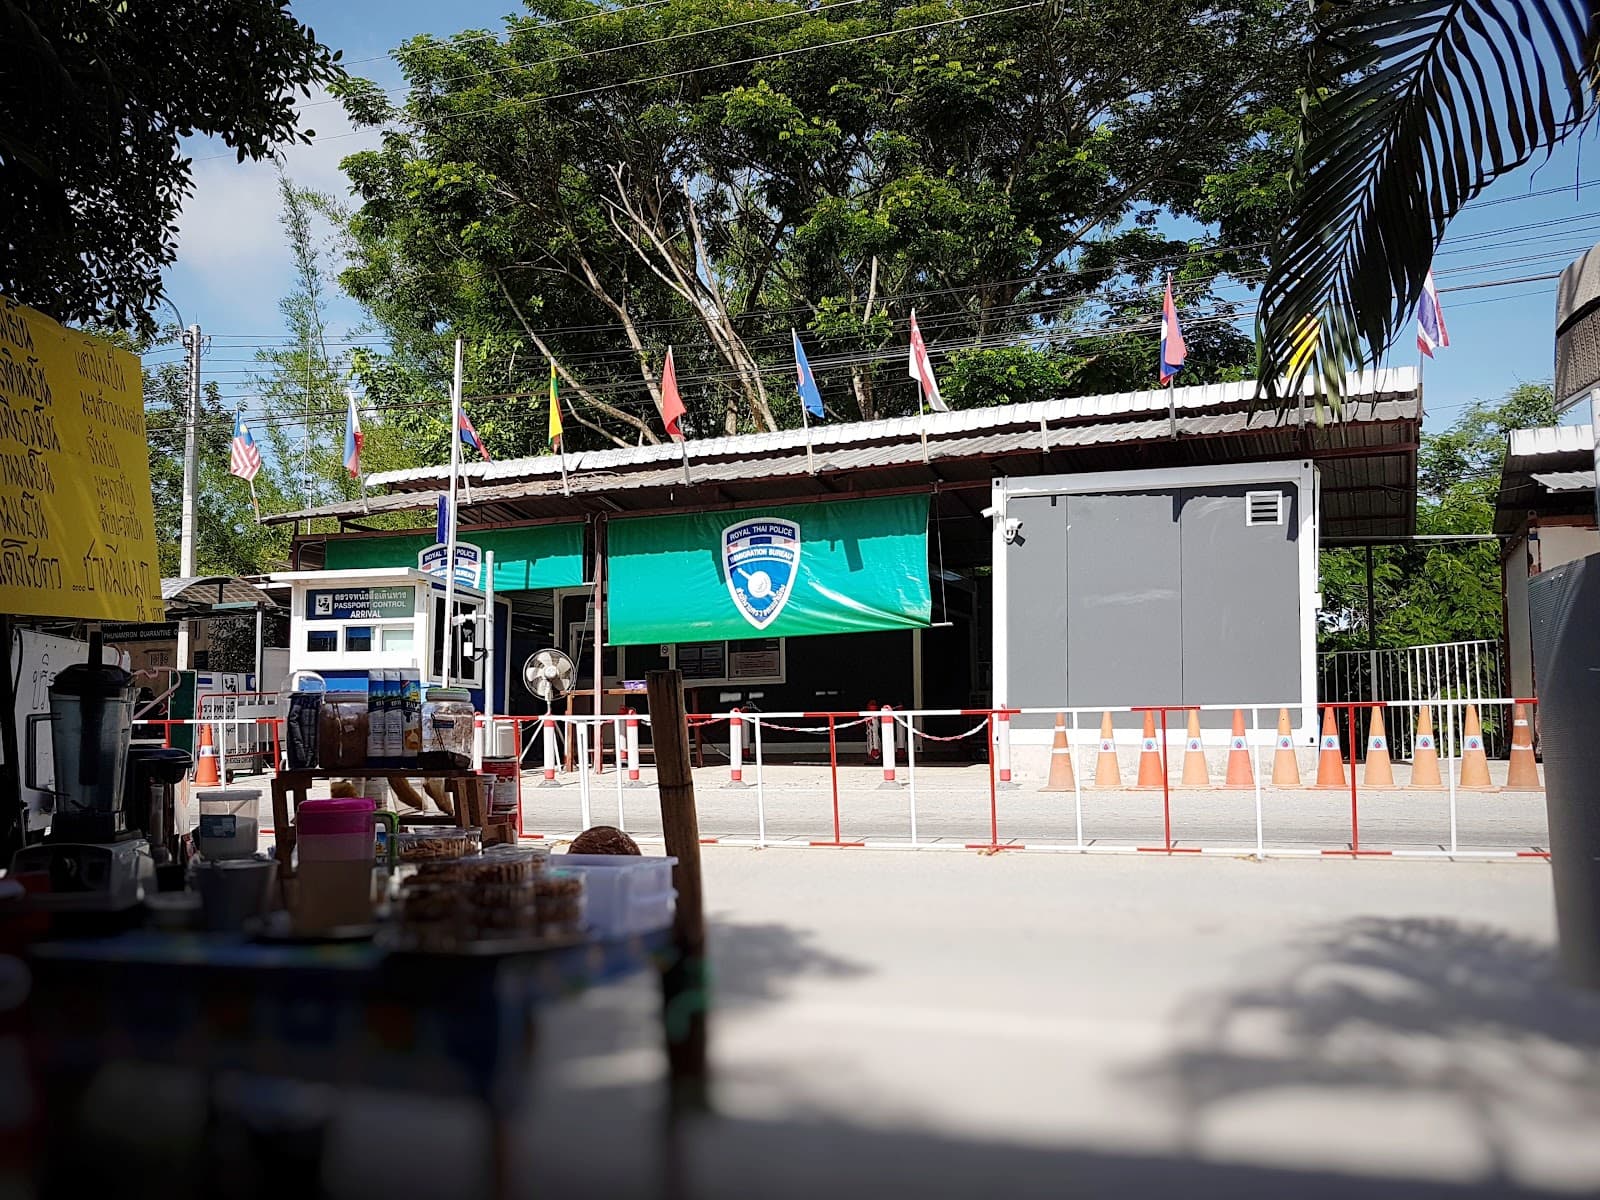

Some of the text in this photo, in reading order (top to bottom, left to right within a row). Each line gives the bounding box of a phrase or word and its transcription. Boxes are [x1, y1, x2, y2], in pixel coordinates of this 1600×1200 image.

[730, 525, 793, 541] ROYAL THAI POLICE
[424, 550, 442, 562] ROYAL
[456, 548, 476, 558] POLICE
[768, 549, 793, 560] BUREAU
[372, 600, 406, 609] CONTROL
[350, 610, 381, 618] ARRIVAL
[139, 629, 170, 638] QUARANTINE
